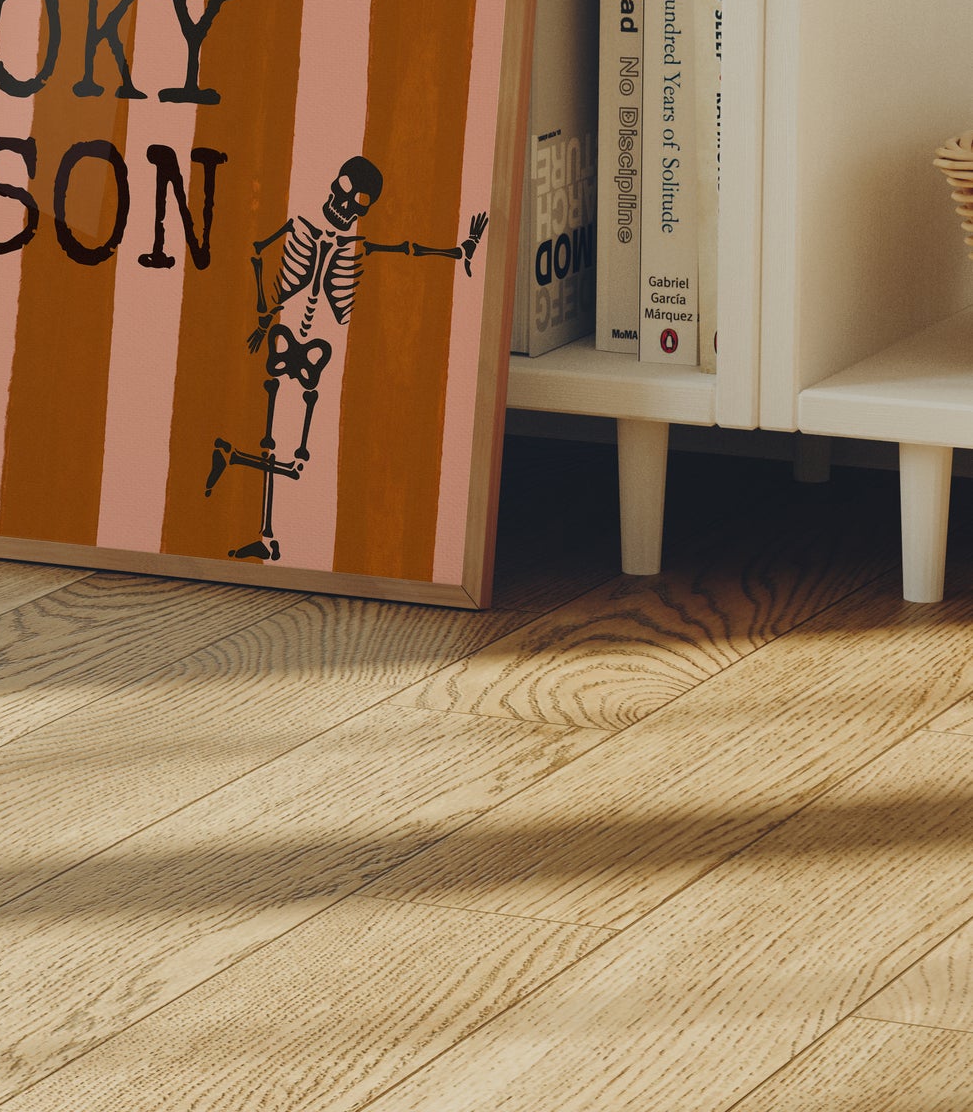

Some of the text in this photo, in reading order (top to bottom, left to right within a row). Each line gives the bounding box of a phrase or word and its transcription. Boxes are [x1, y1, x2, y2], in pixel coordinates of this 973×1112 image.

[619, 56, 639, 96] No
[662, 71, 681, 122] Years
[662, 128, 680, 152] of
[614, 106, 639, 244] Discipline
[661, 157, 680, 234] Solitude
[535, 224, 593, 286] MOD
[648, 276, 689, 289] Gabriel
[651, 292, 686, 305] García
[644, 308, 693, 323] Márquez
[612, 329, 638, 340] MoMA
